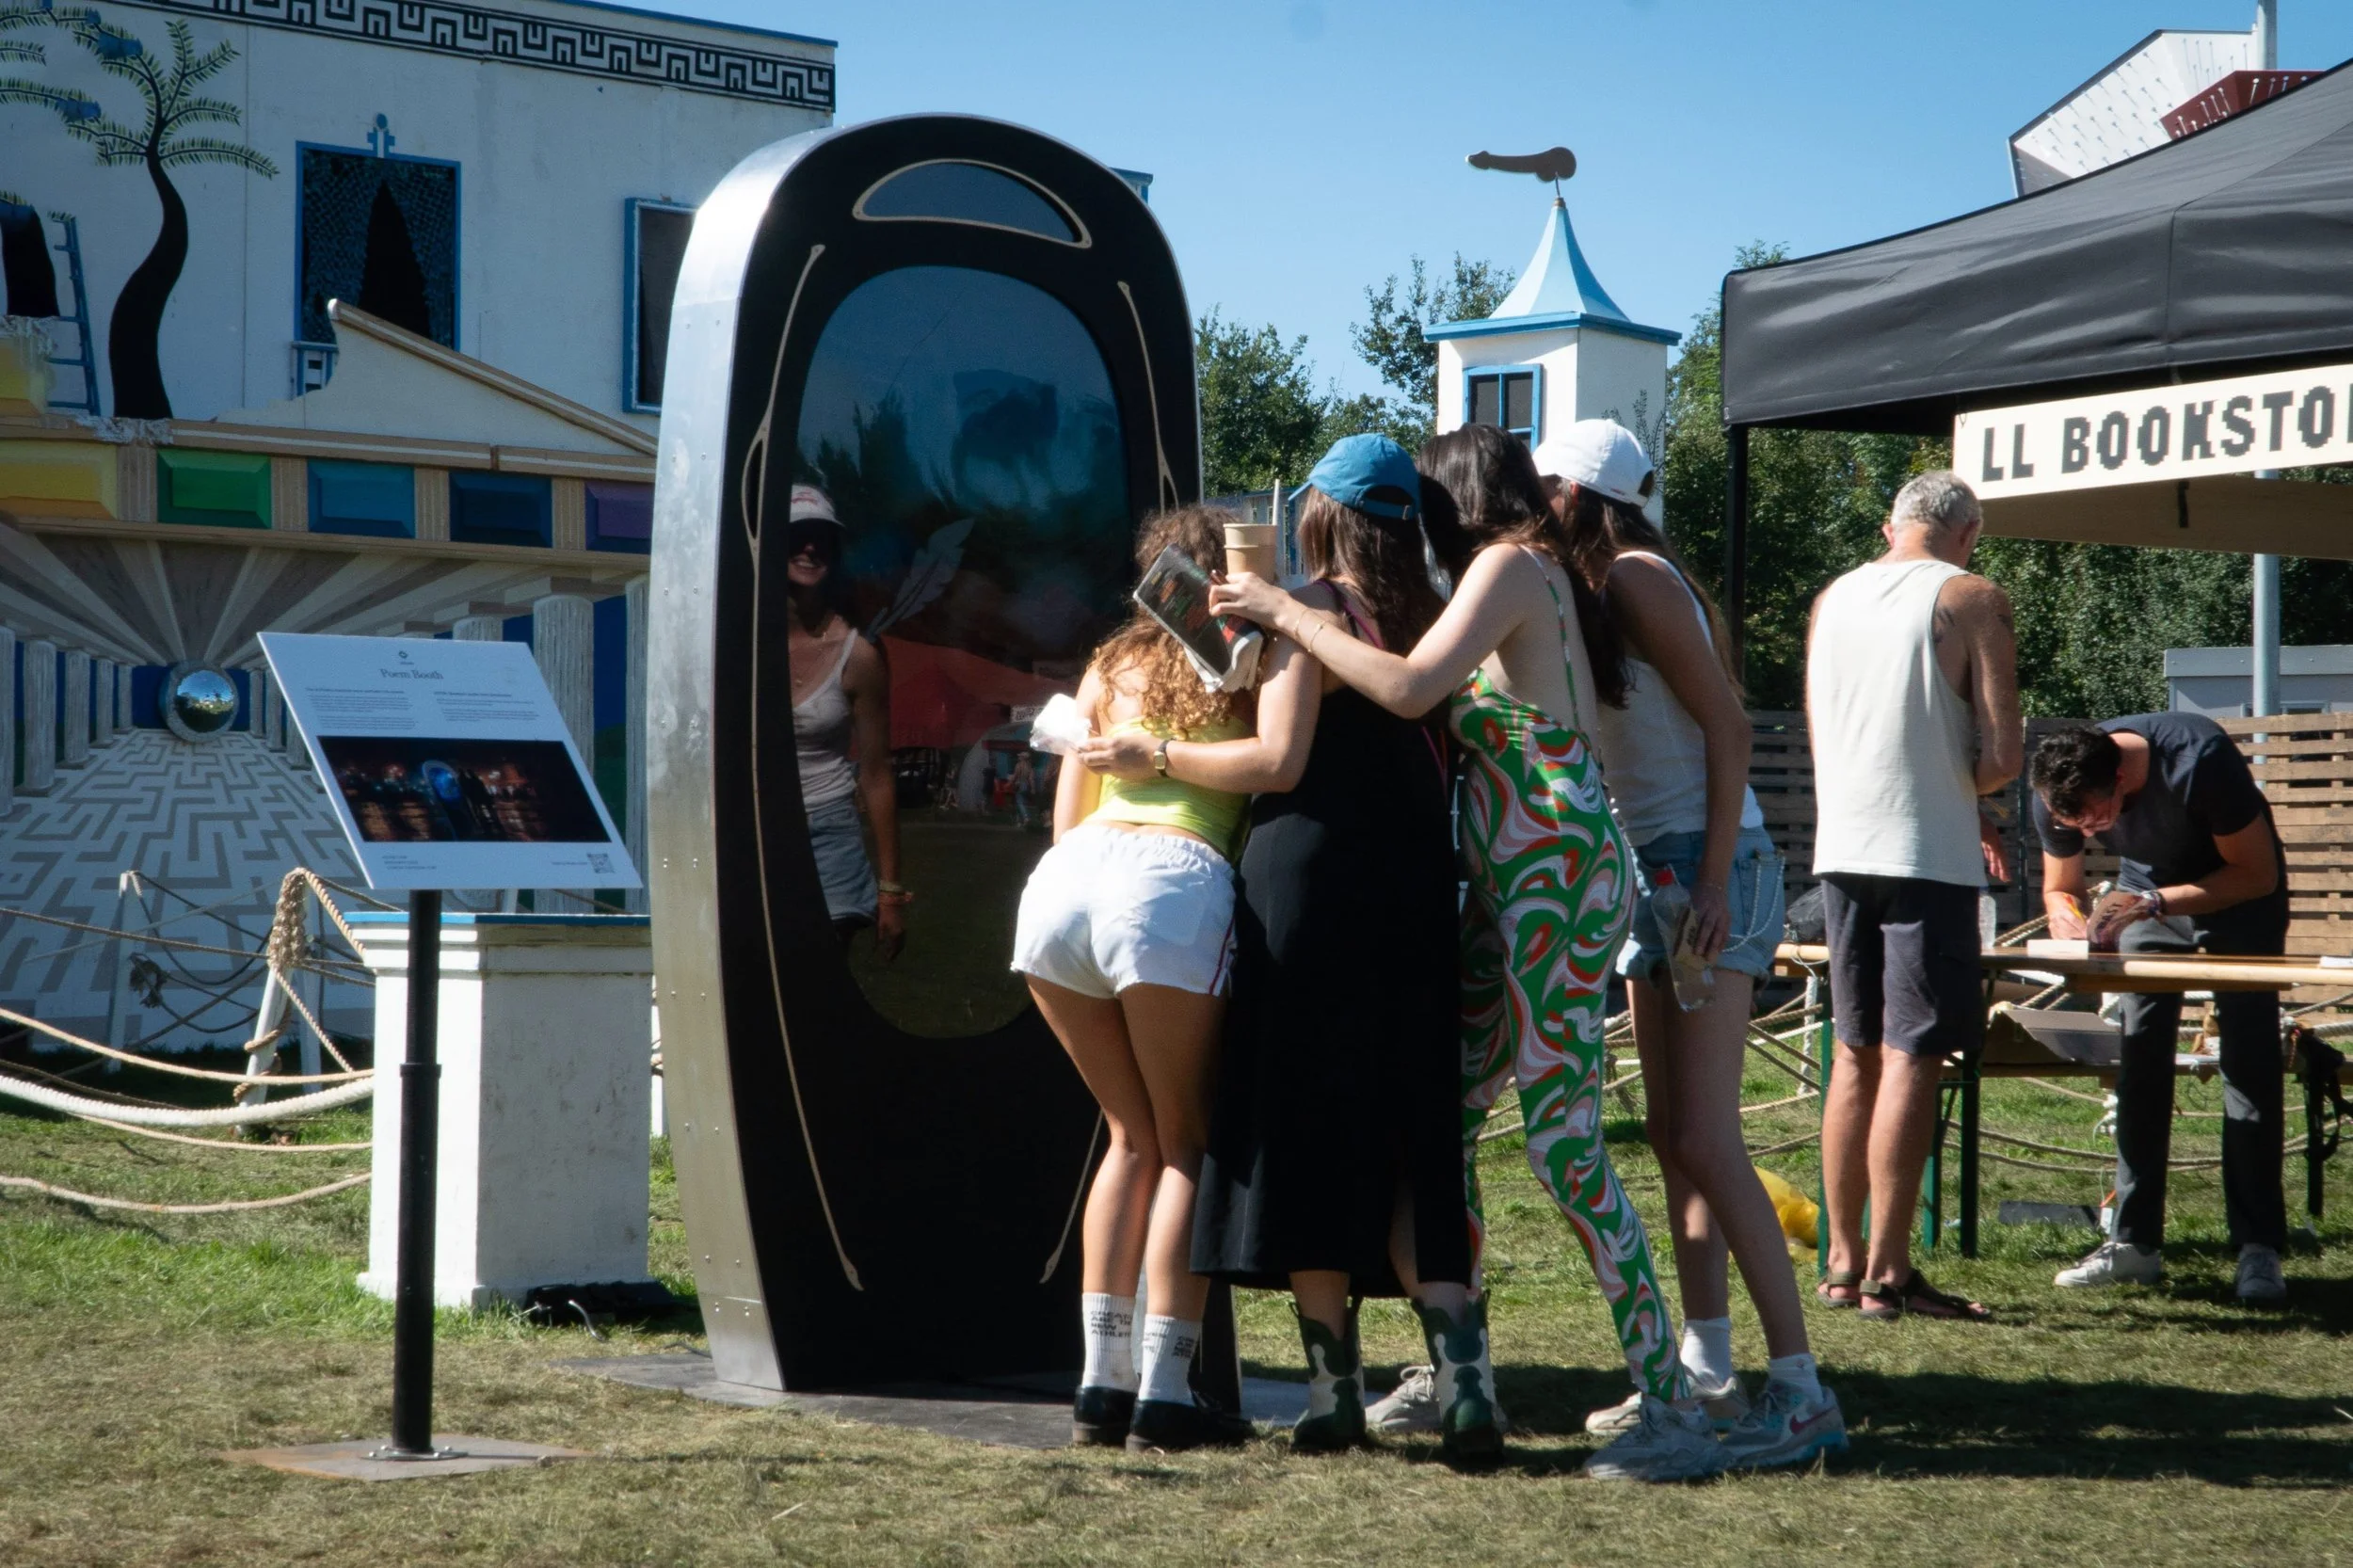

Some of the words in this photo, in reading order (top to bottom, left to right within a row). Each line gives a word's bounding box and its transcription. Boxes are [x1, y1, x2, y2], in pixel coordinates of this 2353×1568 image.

[1982, 424, 2035, 483] LL
[379, 668, 410, 679] Poem
[411, 669, 443, 680] Booth
